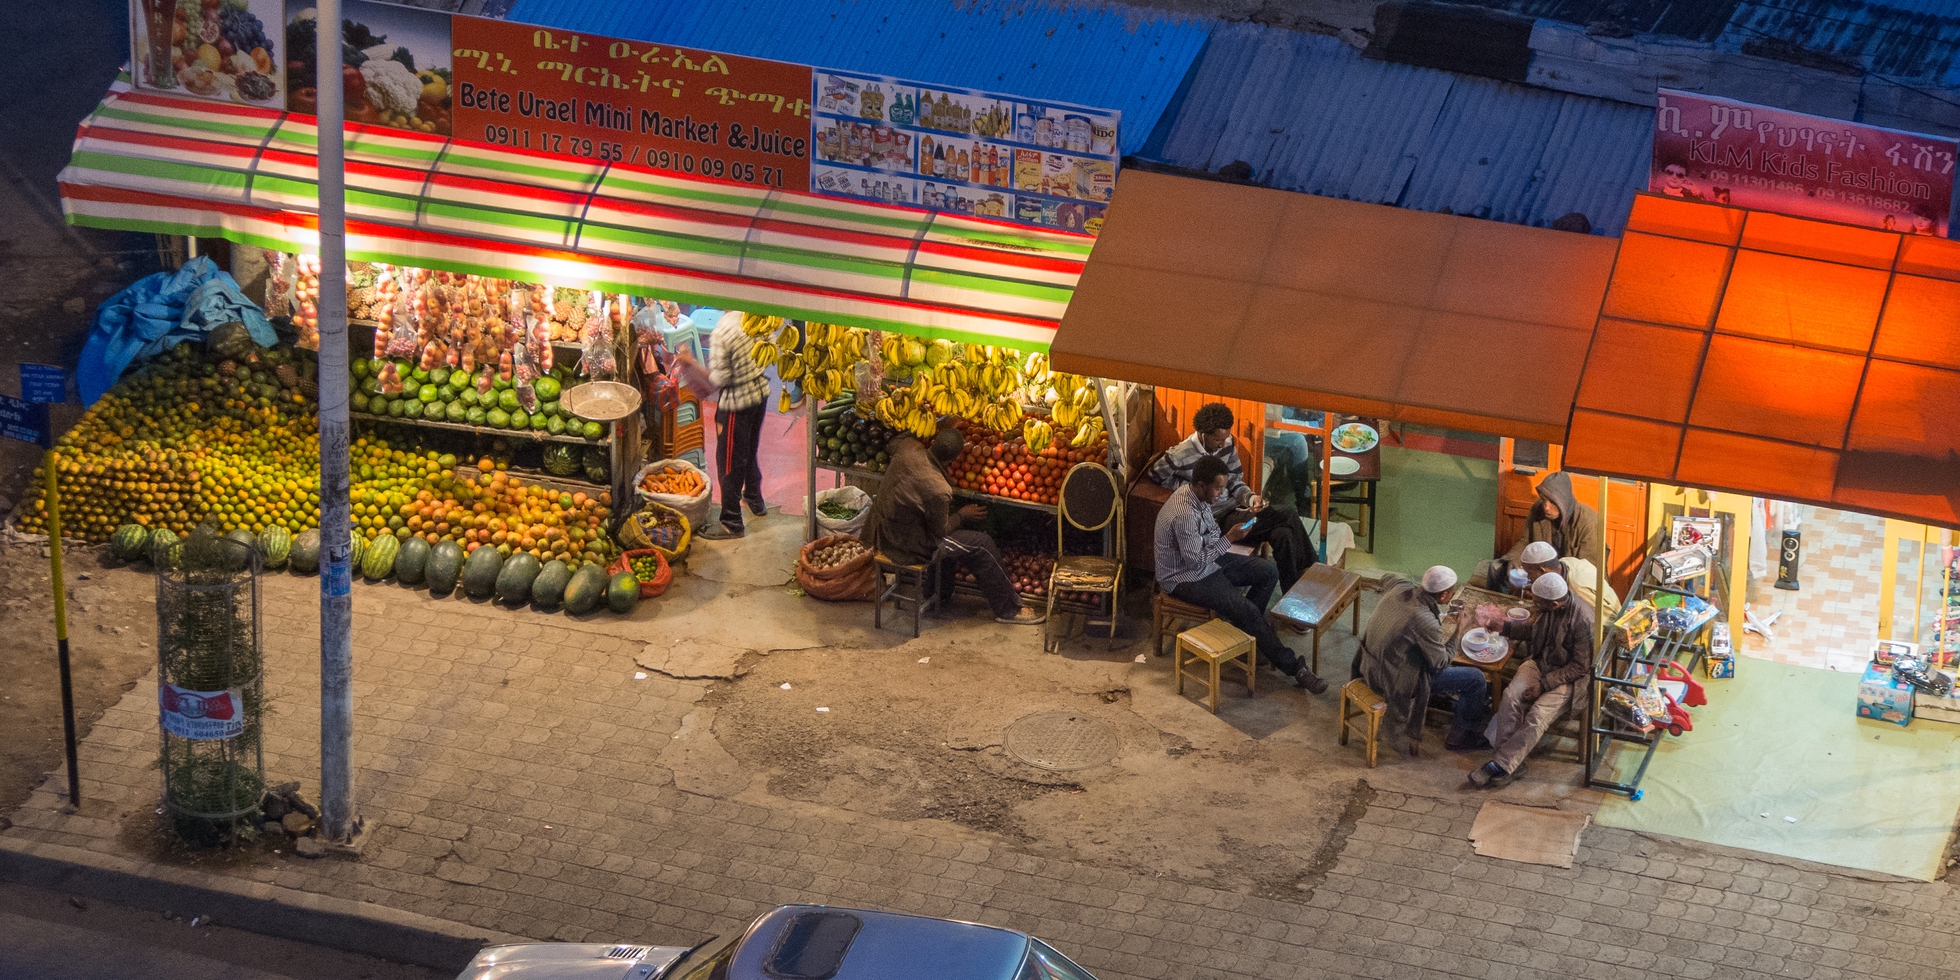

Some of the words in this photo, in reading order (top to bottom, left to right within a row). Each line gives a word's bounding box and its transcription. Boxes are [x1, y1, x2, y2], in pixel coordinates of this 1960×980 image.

[453, 48, 518, 75] ሚኒ
[536, 61, 685, 98] ማርኬትና
[533, 30, 589, 53] ቤተ
[609, 42, 730, 75] ዑራኤል
[460, 82, 510, 113] Bete
[517, 90, 577, 124] Urael
[585, 100, 632, 132] Mini
[640, 108, 719, 145] Market
[485, 124, 530, 148] 0911
[541, 132, 562, 153] 17
[570, 137, 593, 157] 79
[599, 142, 623, 162] 55
[630, 146, 640, 164] /
[646, 149, 695, 173] 0910
[700, 156, 725, 177] 09
[731, 161, 755, 182] 05
[762, 166, 783, 187] 71
[1761, 151, 1819, 180] Kids
[1826, 161, 1931, 200] Fashion
